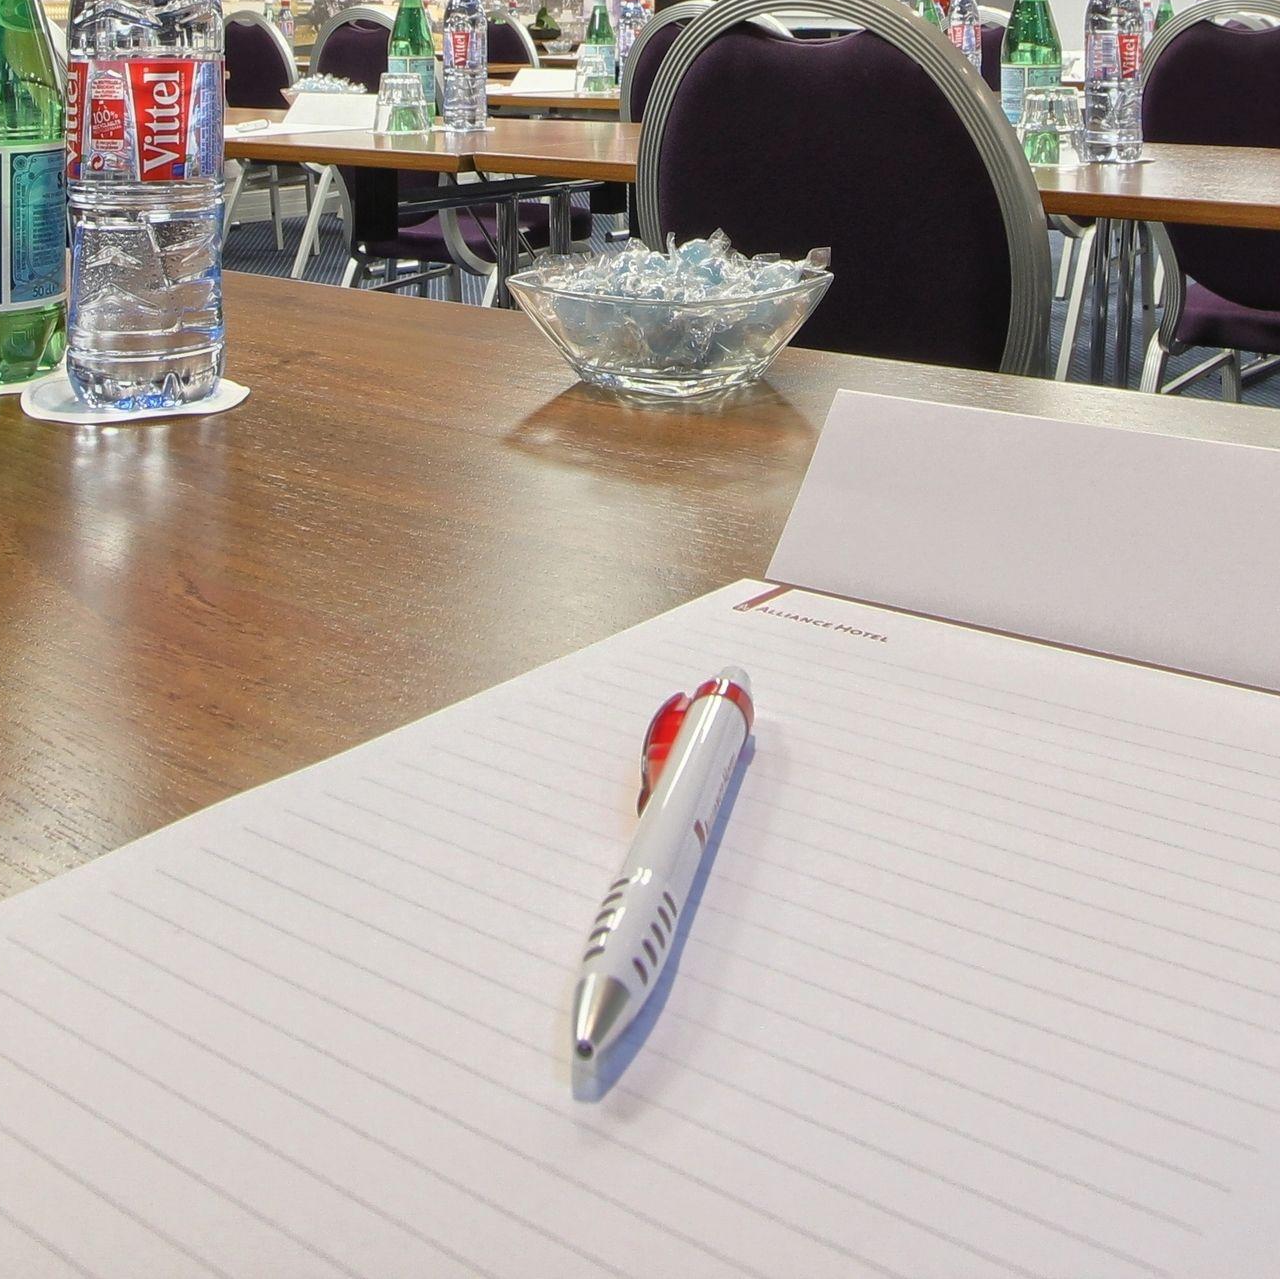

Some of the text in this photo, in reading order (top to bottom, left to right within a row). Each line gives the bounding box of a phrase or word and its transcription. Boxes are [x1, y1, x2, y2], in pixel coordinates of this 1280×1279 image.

[454, 32, 468, 67] Vittel
[1121, 38, 1136, 78] Vittel
[93, 109, 119, 124] 100%
[142, 70, 180, 174] Vittel
[33, 286, 44, 297] 50
[755, 605, 889, 644] ALLIANCE HOTEL
